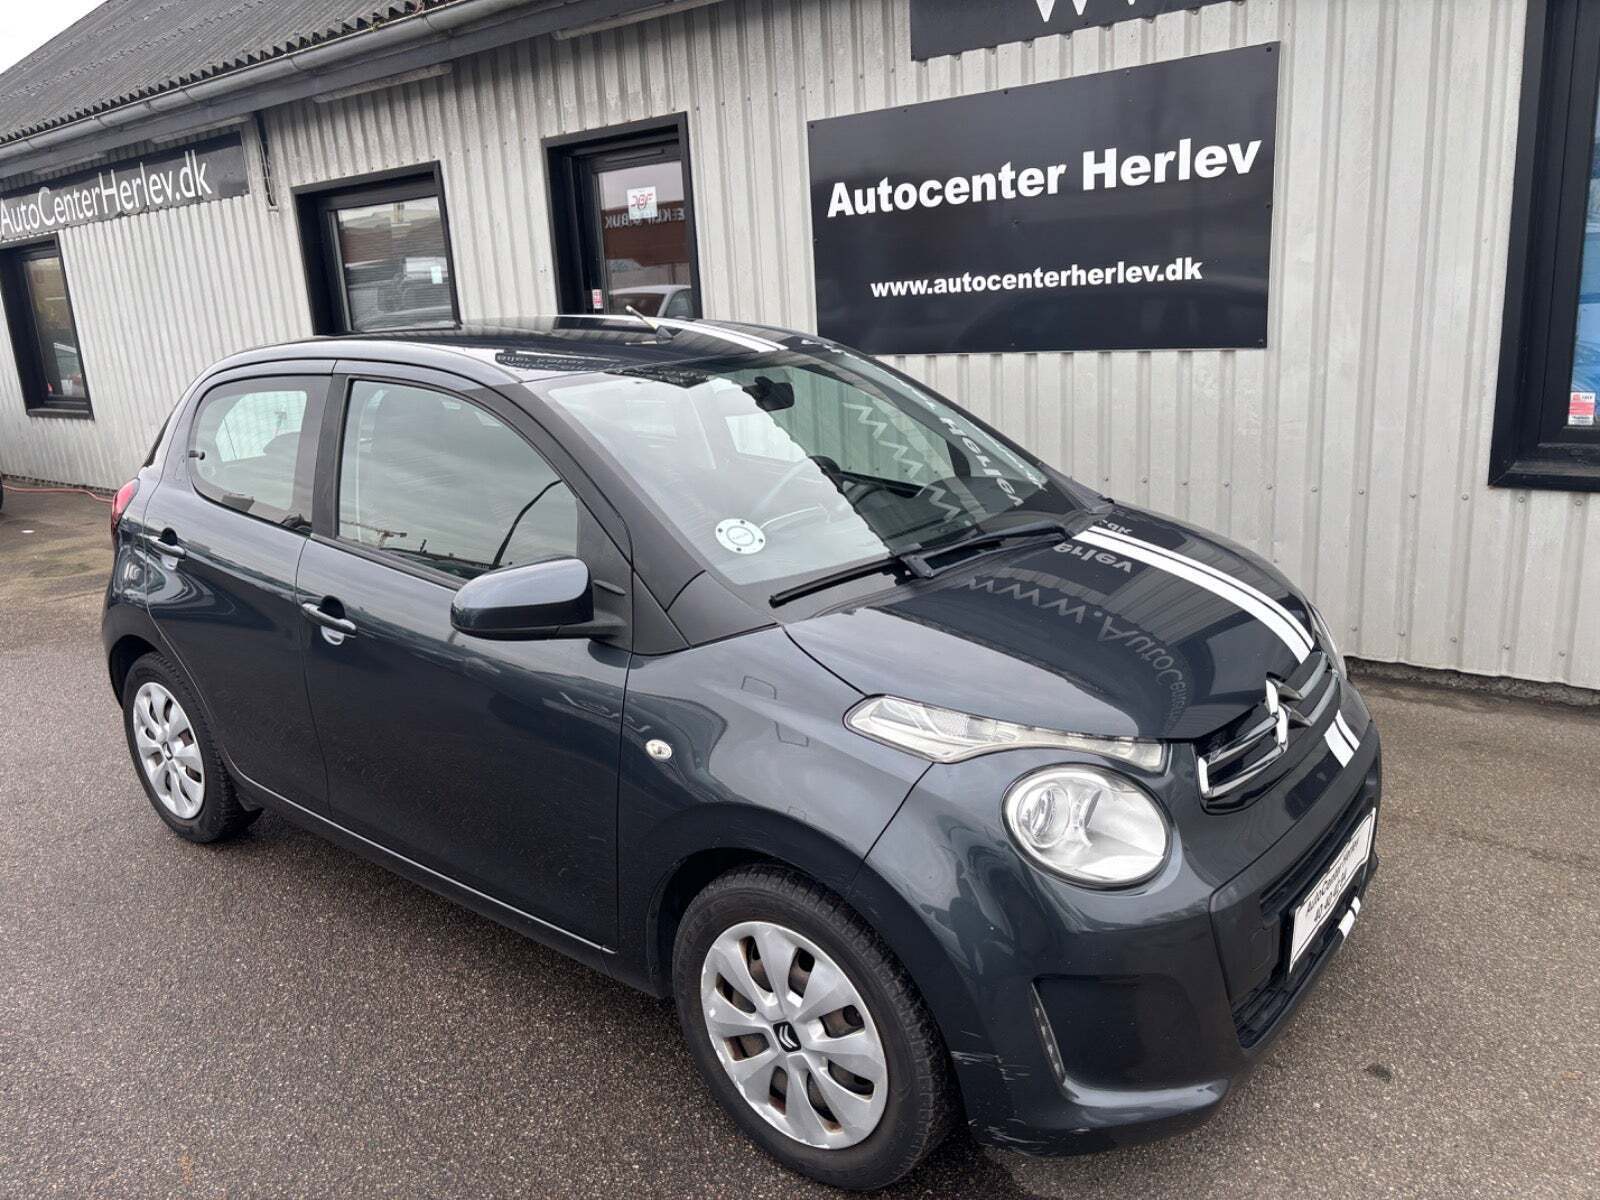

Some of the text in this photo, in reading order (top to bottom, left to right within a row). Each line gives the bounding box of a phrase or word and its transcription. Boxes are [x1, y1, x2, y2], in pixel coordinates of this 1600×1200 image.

[827, 138, 1263, 218] Autocenter Herlev
[870, 257, 1203, 298] www.autocenterherlev.dk
